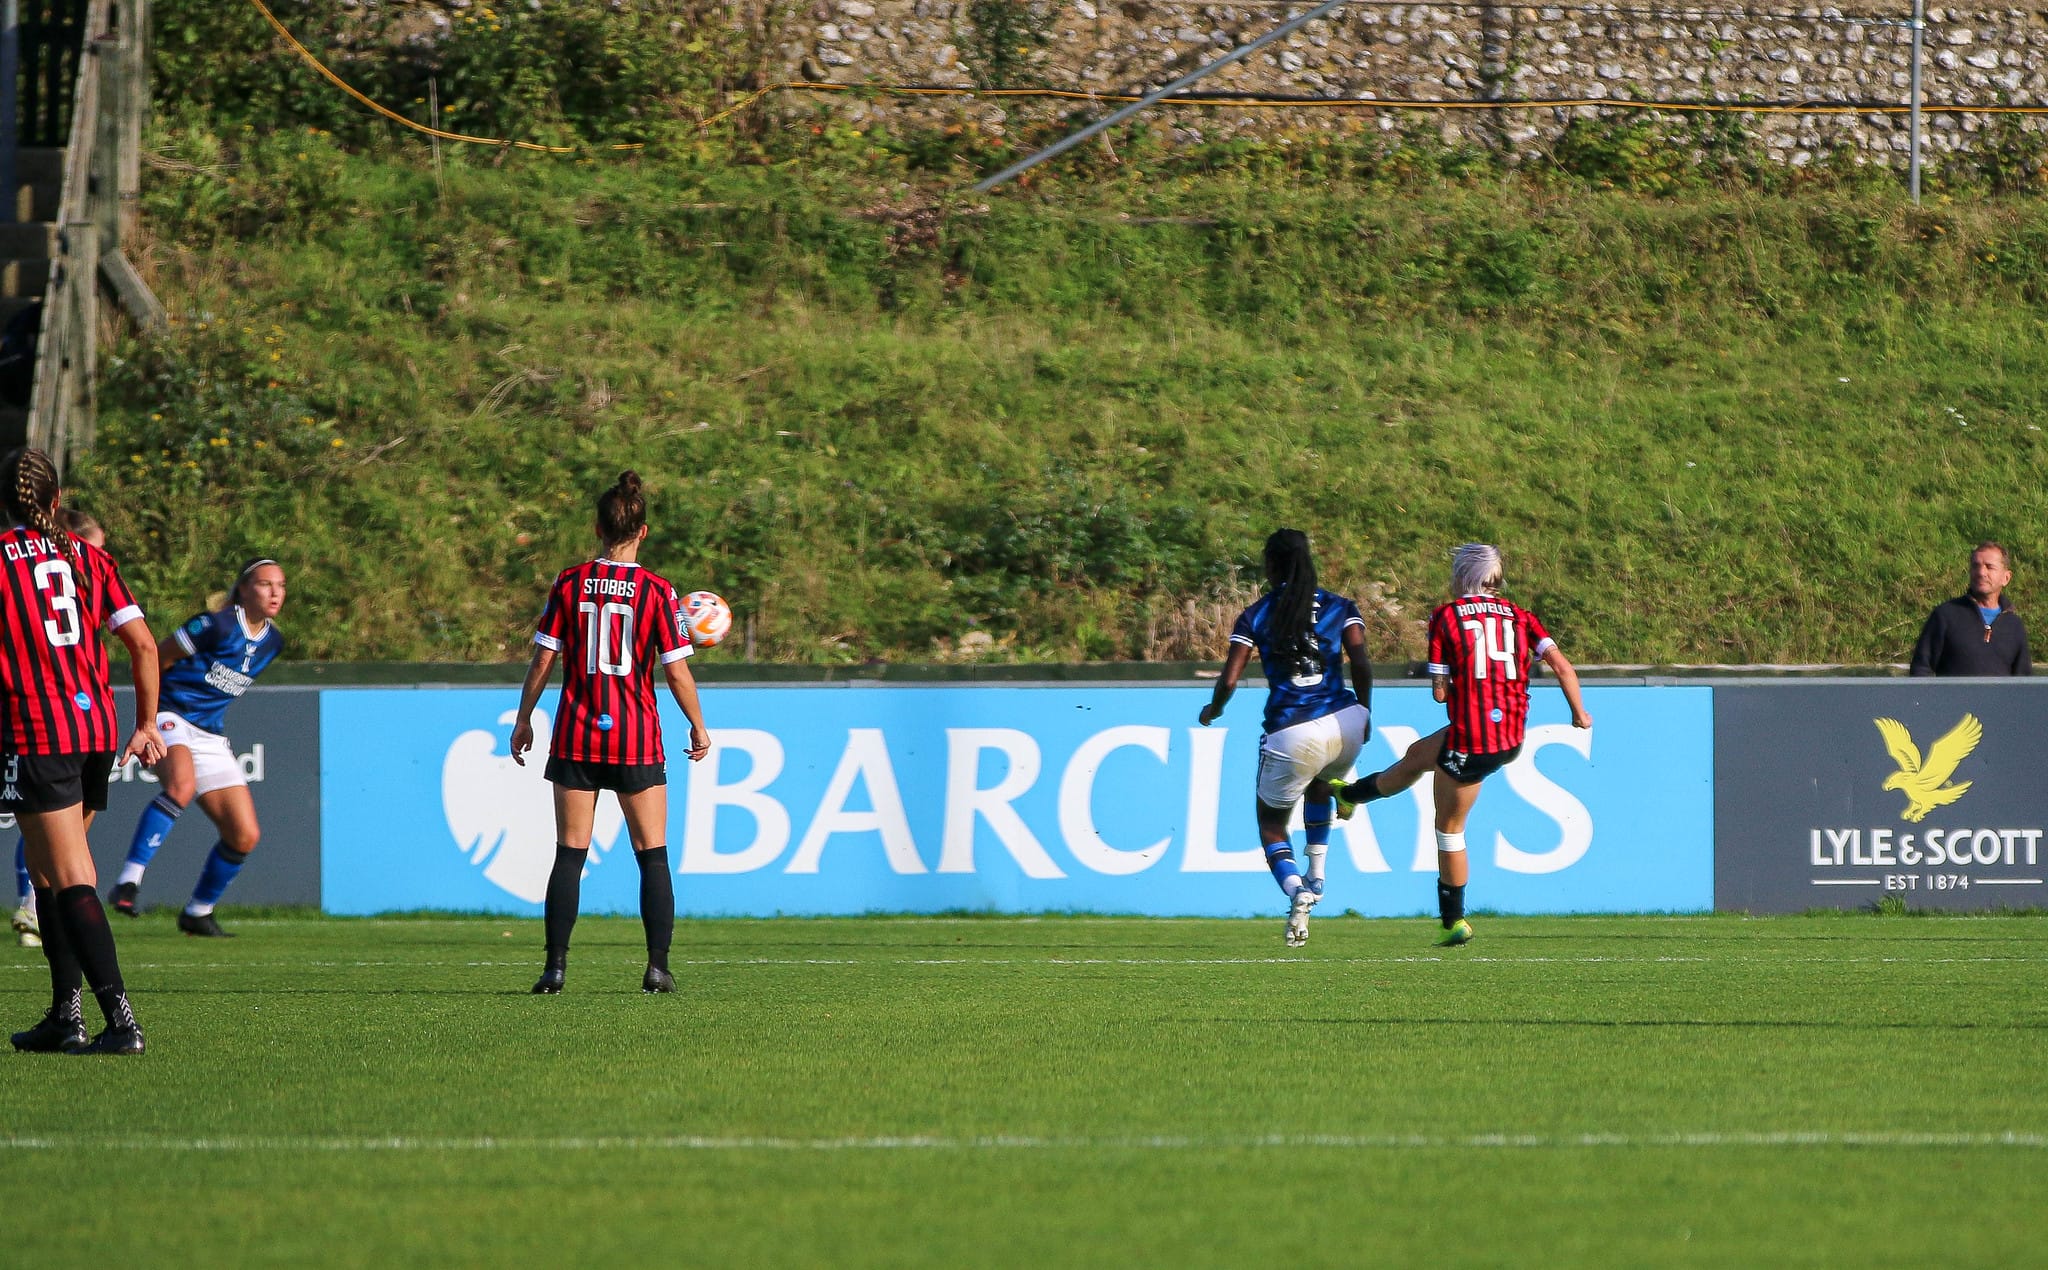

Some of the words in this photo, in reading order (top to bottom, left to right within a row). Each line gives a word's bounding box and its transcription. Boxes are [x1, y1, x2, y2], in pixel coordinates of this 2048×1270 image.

[4, 537, 82, 561] CLEVEY
[584, 578, 637, 598] STOBBS
[34, 559, 80, 647] 3
[1456, 602, 1515, 617] HOWELLS
[579, 601, 634, 677] 10
[1462, 617, 1518, 680] 14
[1884, 875, 1920, 890] EST
[1926, 875, 1969, 890] 1874
